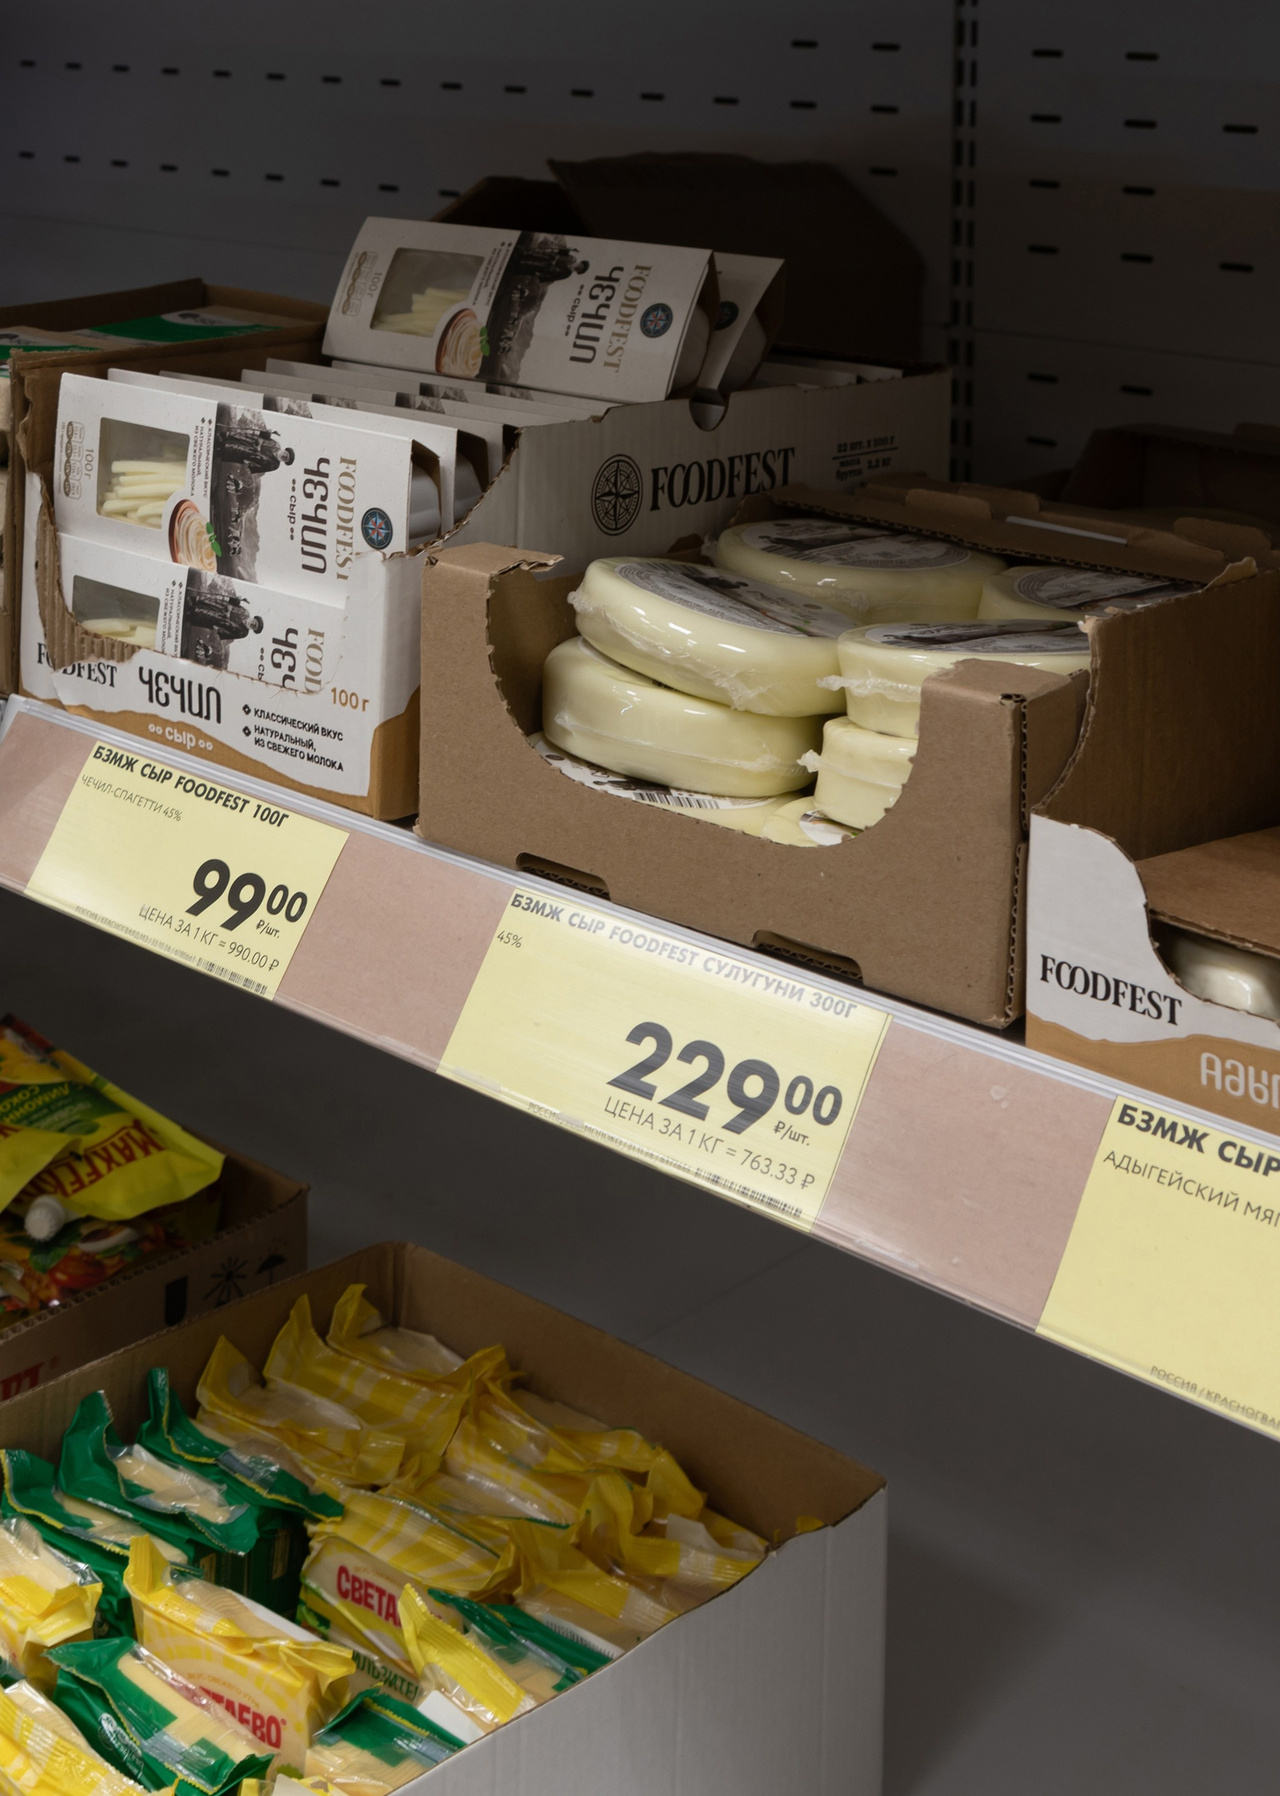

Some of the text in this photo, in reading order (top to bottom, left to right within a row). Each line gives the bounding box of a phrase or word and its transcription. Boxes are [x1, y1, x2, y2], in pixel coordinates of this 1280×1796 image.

[603, 264, 653, 373] FOODFEST
[650, 447, 795, 511] FOODFEST
[37, 642, 118, 688] FDFEST
[165, 724, 196, 750] сыр
[254, 708, 344, 741] КЛАССИЧЕСКИЙ ВКУС
[254, 724, 317, 752] НАТУРАЛЬНЫЙ,
[254, 736, 344, 772] ИЗ СВЕЖЕГО МОЛОКА
[81, 774, 183, 822] ЧЕЧИЛ-СПАГЕТТИ 45%
[92, 745, 289, 828] БЗМЖ СЫР FOODFEST 100Г
[185, 858, 308, 932] 99 00
[138, 904, 174, 929] ЦЕНА
[174, 918, 193, 936] ЗА
[199, 928, 219, 947] КГ
[227, 941, 268, 969] 990.00
[496, 930, 523, 949] 45%
[510, 892, 858, 1020] БЗМЖ СЫР FOODFEST СУЛУГУНИ 300Г
[1040, 953, 1182, 1027] FOODFEST
[606, 1021, 843, 1136] 229 00
[603, 1096, 656, 1132] ЦЕНА
[658, 1116, 685, 1140] ЗА
[696, 1132, 724, 1155] КГ
[739, 1148, 798, 1185] 763.33
[1117, 1103, 1280, 1179] БЗМЖ СЫР
[1103, 1150, 1240, 1212] АДЫГЕЙСКИЙ
[1150, 1365, 1198, 1397] РОССИЯ
